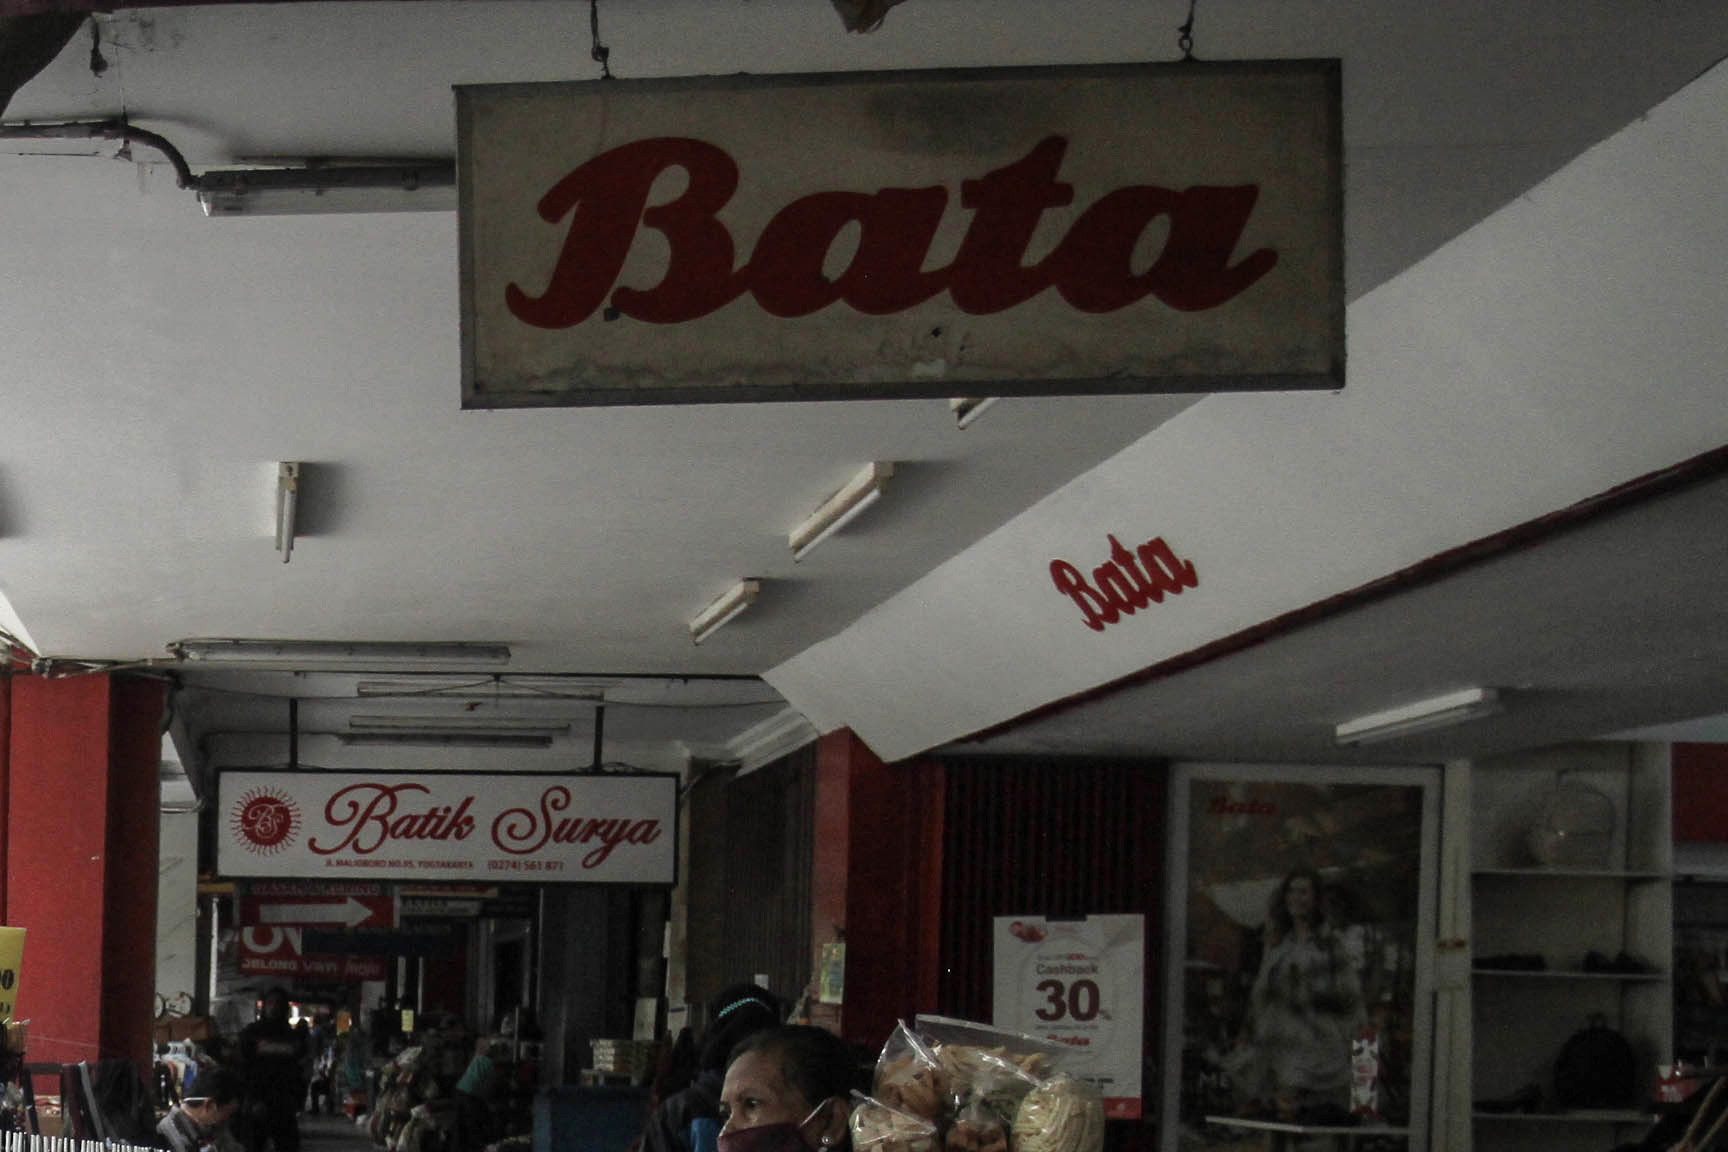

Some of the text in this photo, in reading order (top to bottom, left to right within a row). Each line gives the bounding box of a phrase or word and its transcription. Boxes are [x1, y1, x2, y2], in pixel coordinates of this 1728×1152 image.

[505, 135, 1278, 329] Bata
[1049, 533, 1199, 632] Bata
[308, 783, 662, 869] Batik Surya
[1036, 964, 1099, 976] Cashback
